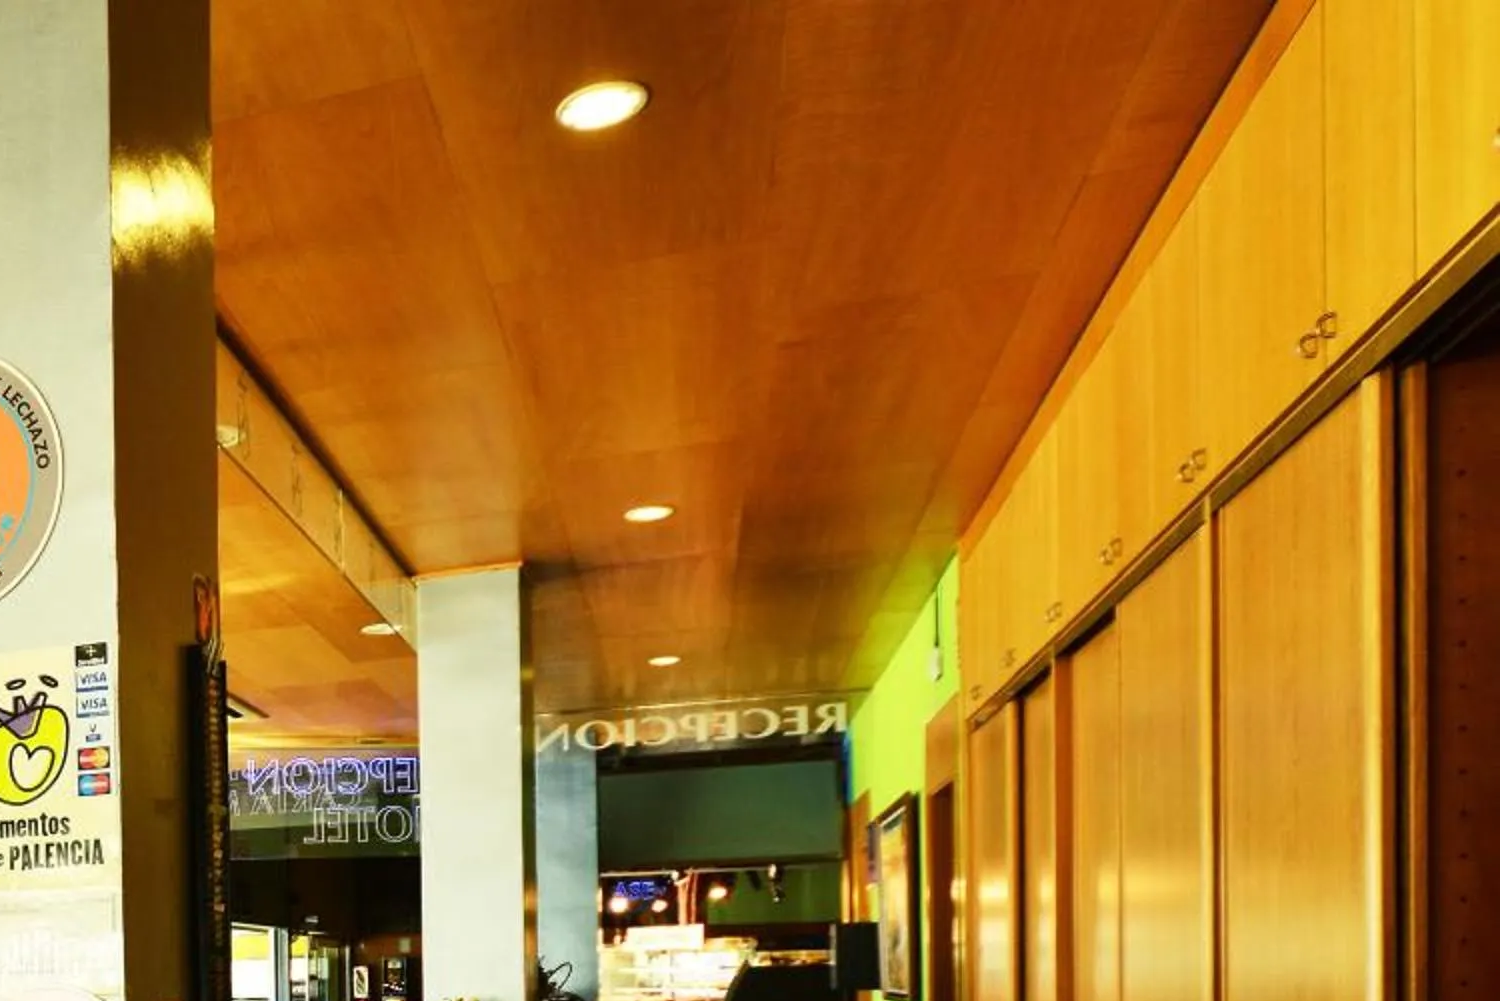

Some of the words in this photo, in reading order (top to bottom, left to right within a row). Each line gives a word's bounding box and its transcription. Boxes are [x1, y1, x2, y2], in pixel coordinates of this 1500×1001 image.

[2, 384, 51, 470] LECHAZO
[80, 671, 107, 686] VISA
[81, 697, 108, 711] VISA
[9, 839, 105, 871] PALENCIA
